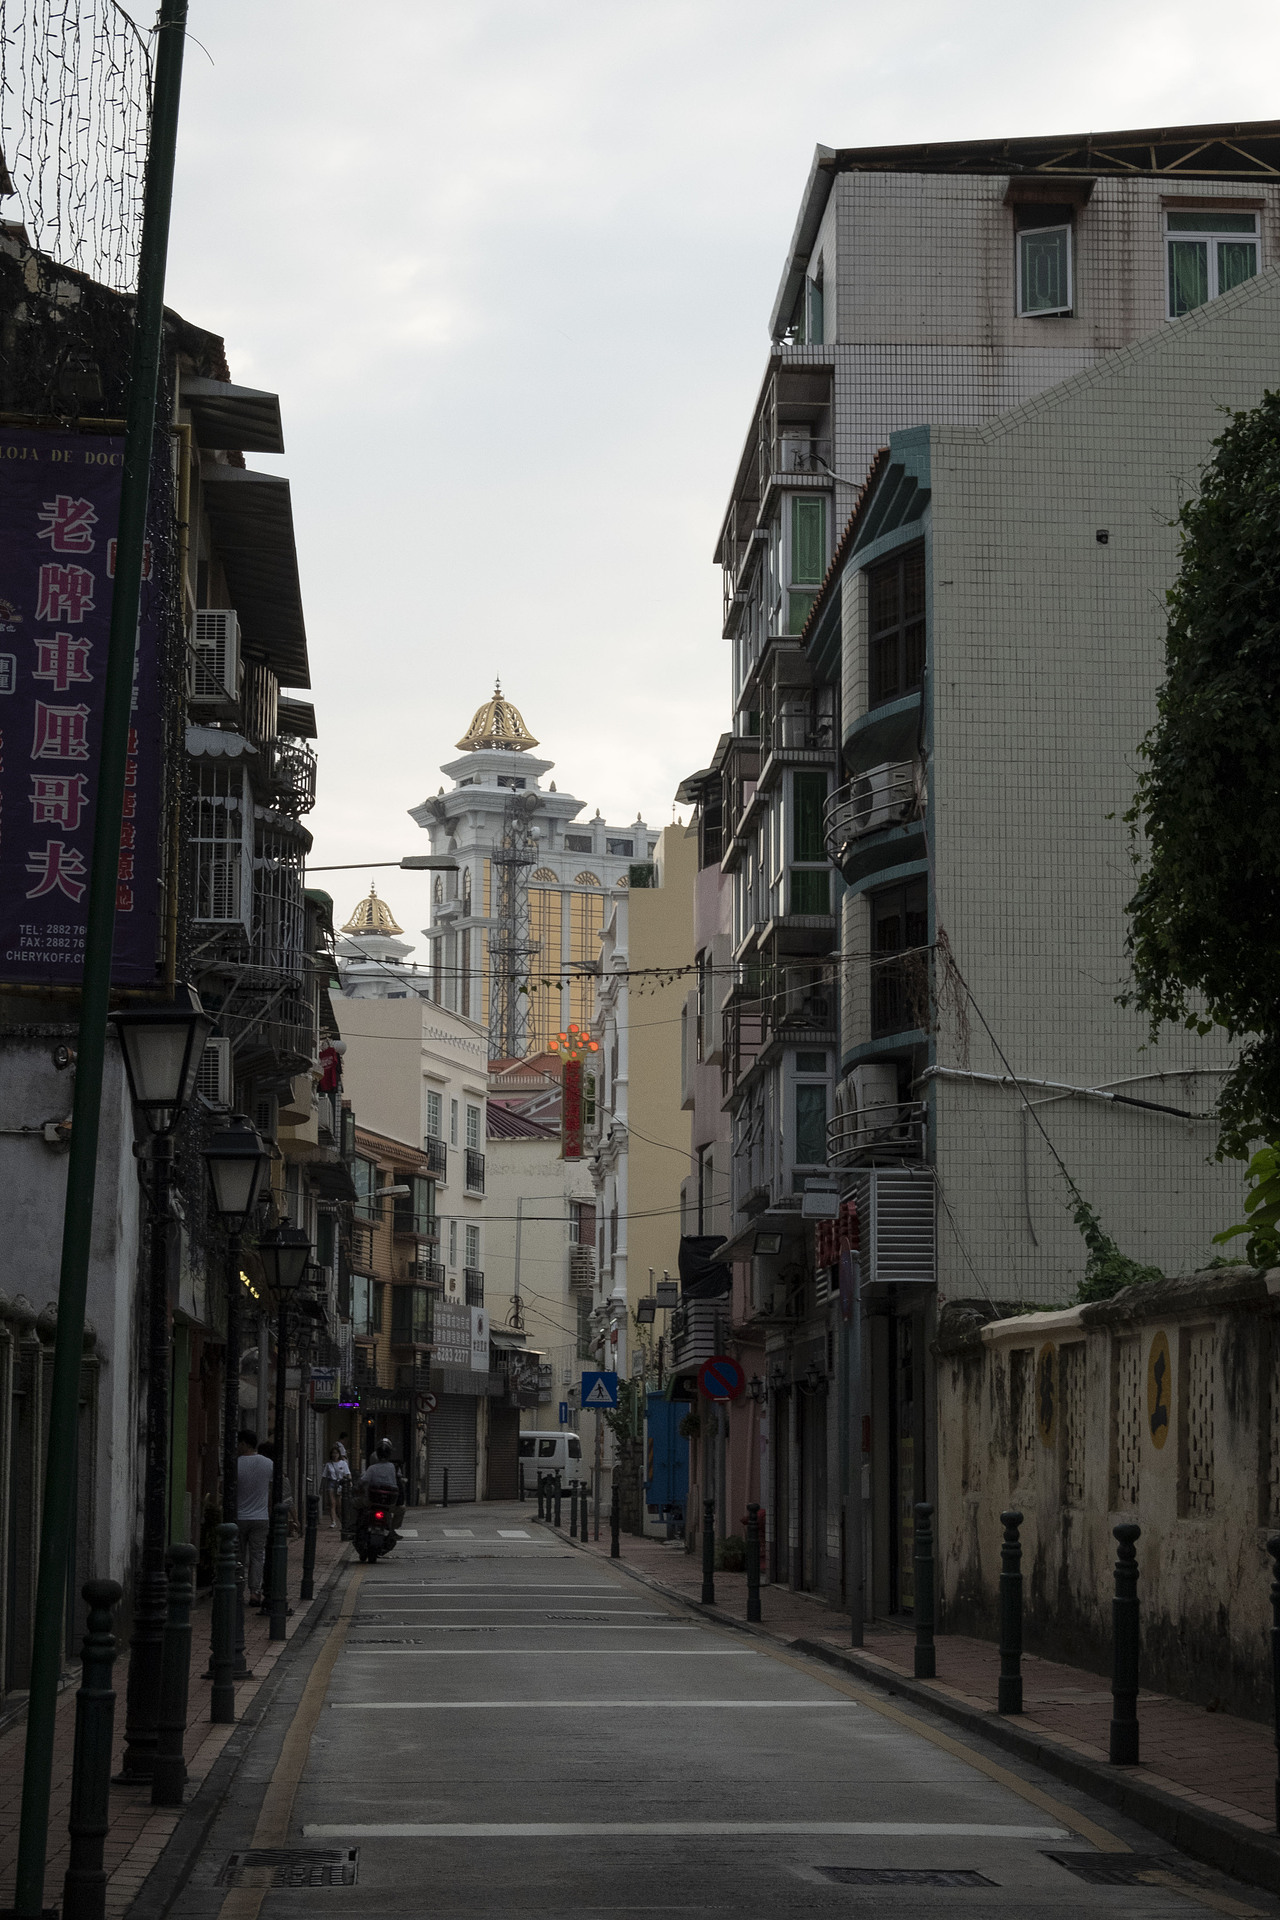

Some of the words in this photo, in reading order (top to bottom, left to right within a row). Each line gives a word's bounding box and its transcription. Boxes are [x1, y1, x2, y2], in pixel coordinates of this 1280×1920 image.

[51, 449, 73, 463] DE
[25, 494, 99, 903] 老牌車厘哥夫
[19, 924, 43, 935] TEL:
[46, 924, 71, 935] 2882
[20, 937, 44, 948] FAX:
[46, 937, 70, 948] 2882
[315, 1380, 334, 1391] CITY
